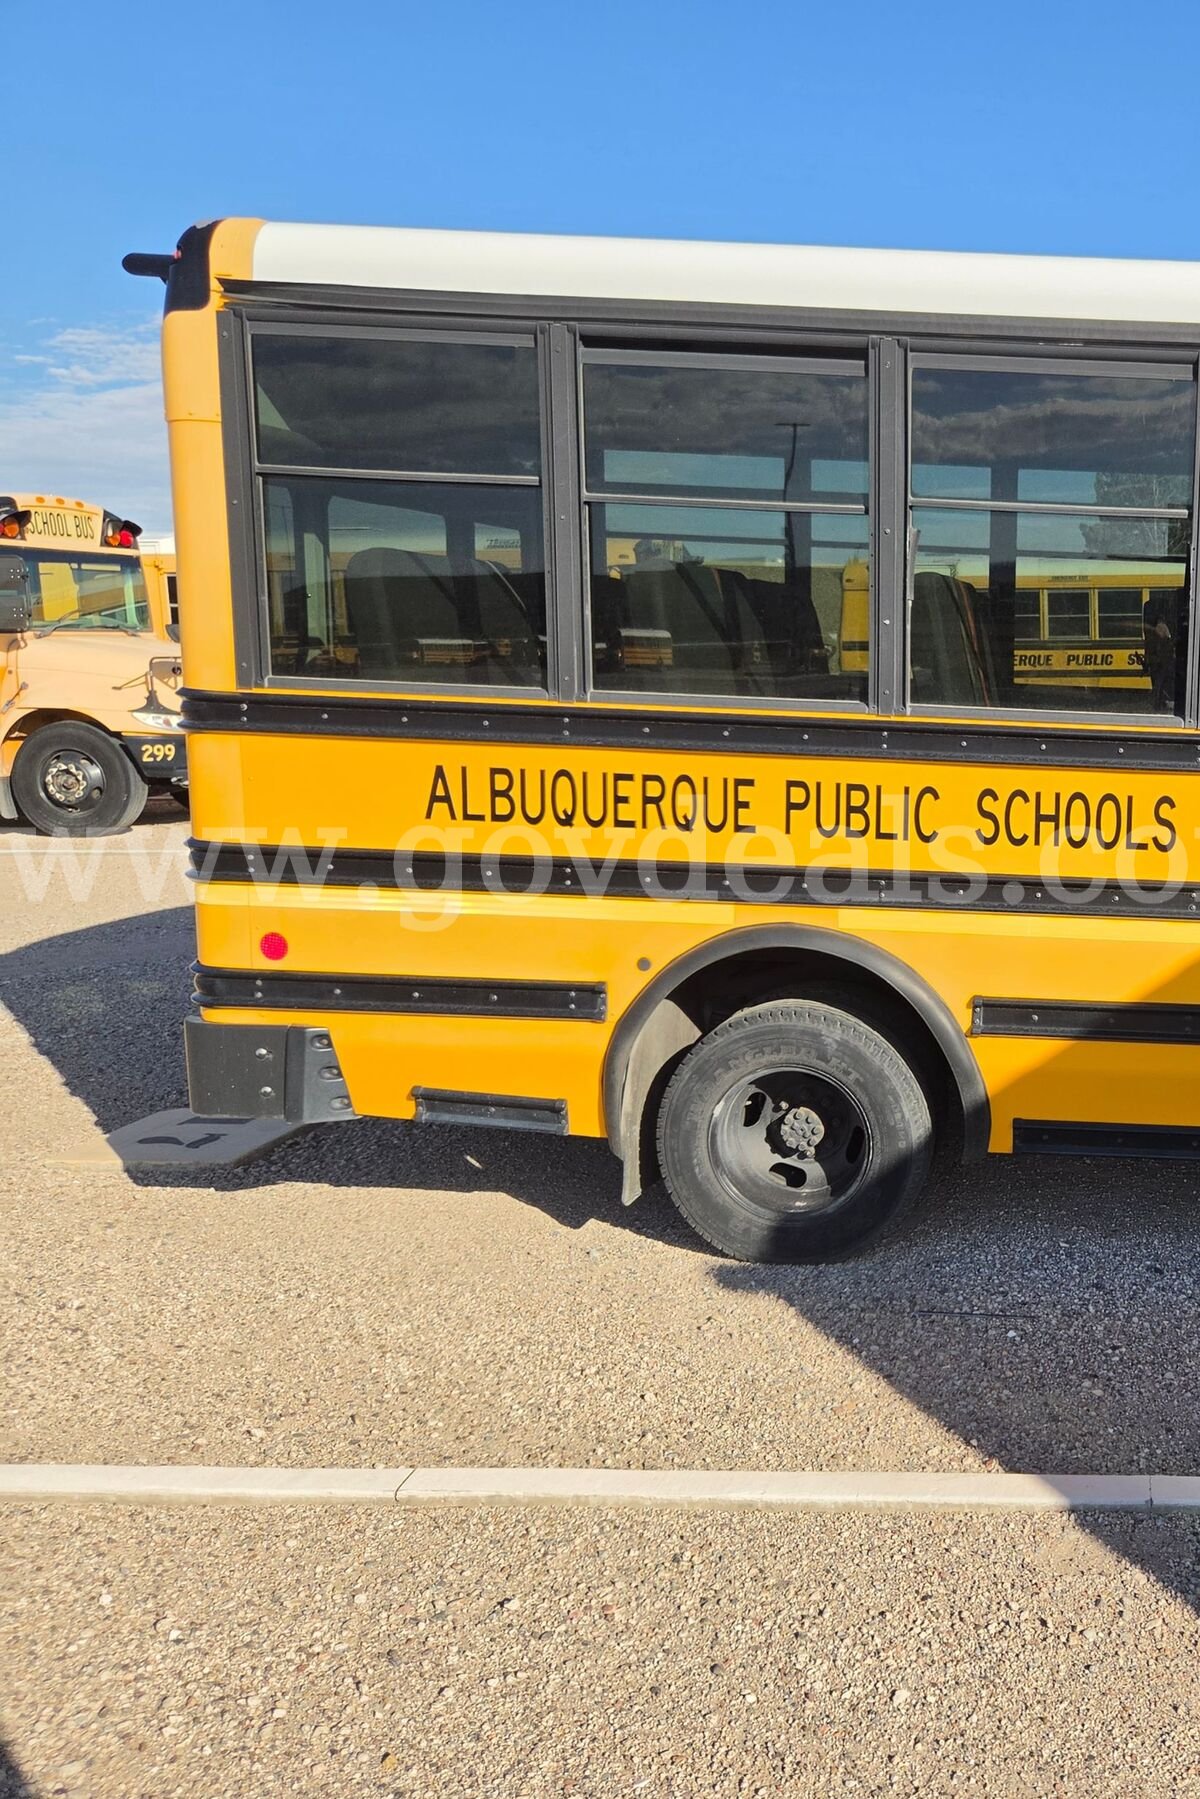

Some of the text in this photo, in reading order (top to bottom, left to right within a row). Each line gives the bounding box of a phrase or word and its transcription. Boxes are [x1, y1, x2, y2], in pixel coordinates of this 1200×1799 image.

[74, 515, 95, 540] BUS
[1066, 653, 1114, 667] PUBLIC
[141, 744, 176, 762] 299
[425, 765, 1178, 852] ALBUQUERQUE PUBLIC SCHOOLS
